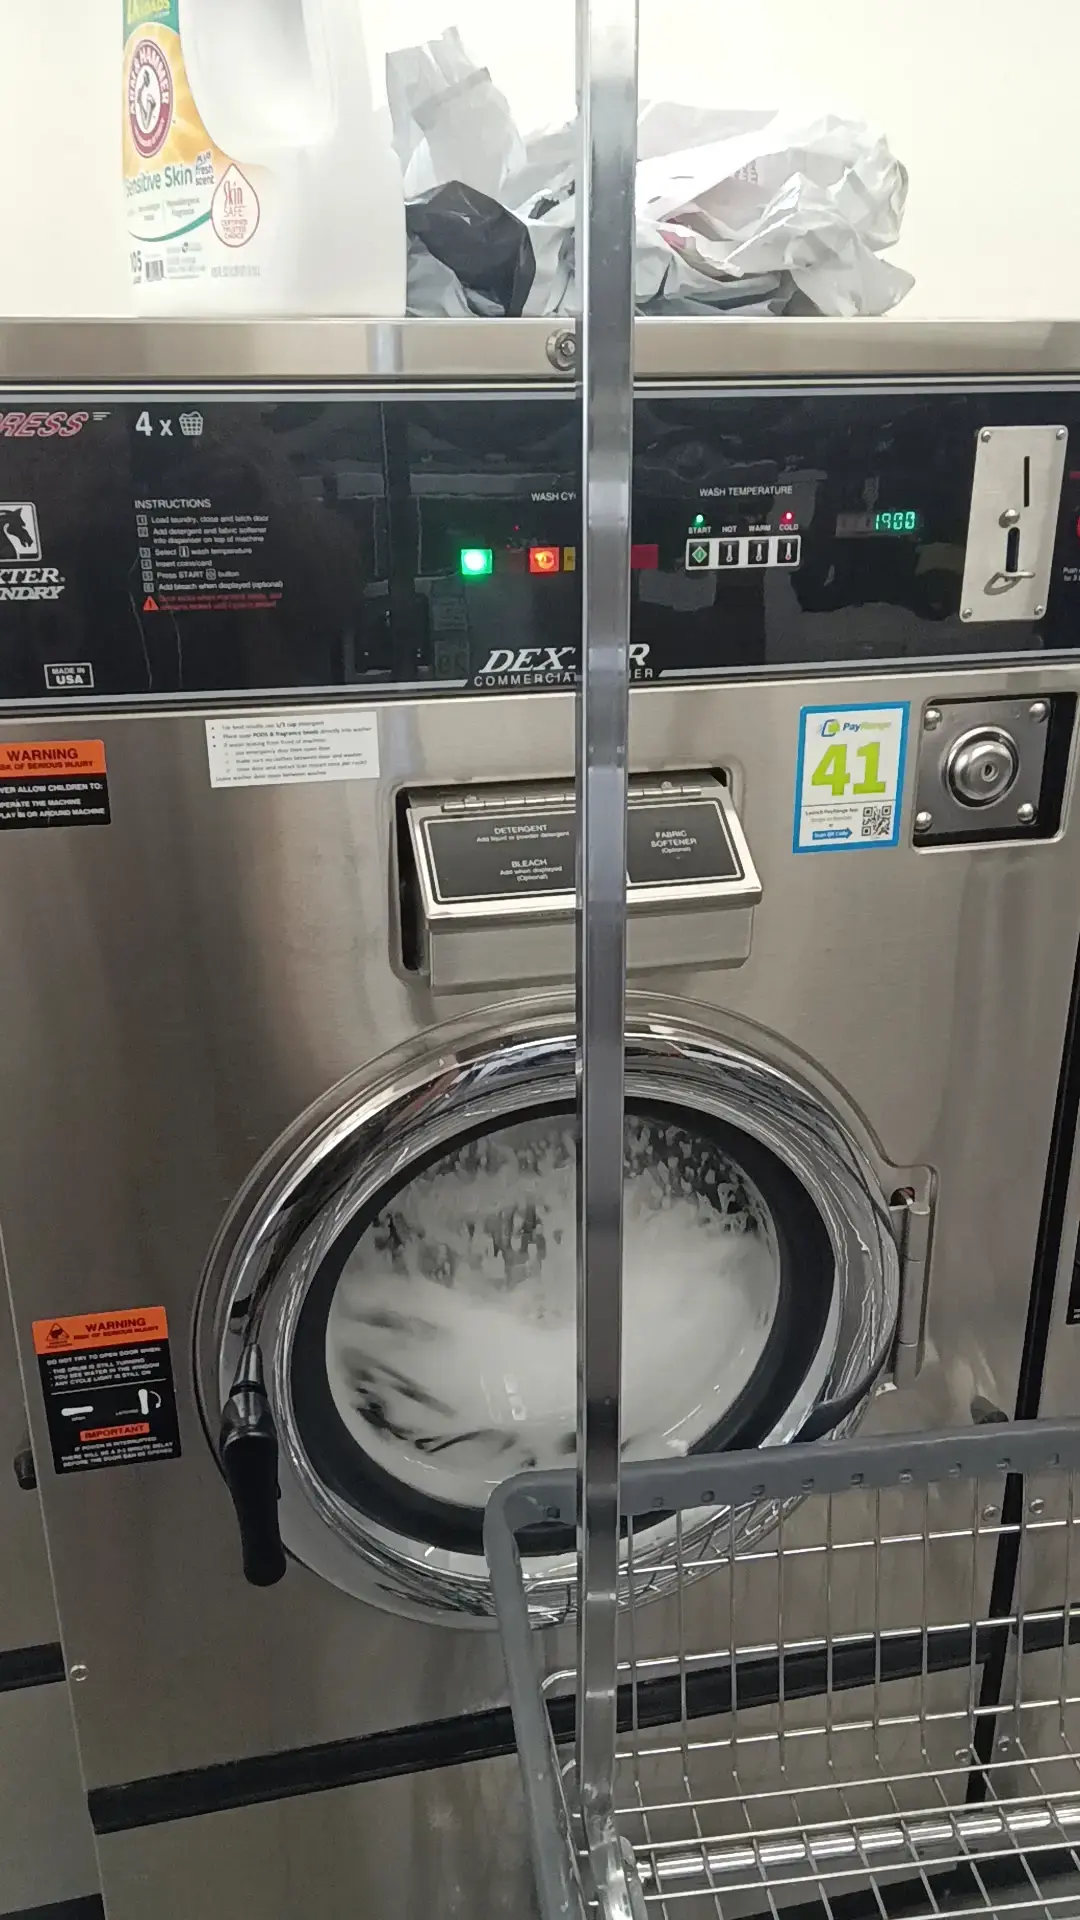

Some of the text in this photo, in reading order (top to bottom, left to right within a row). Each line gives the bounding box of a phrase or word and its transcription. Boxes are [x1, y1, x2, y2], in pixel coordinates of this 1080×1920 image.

[165, 164, 193, 188] Skin
[223, 180, 243, 208] Skin
[0, 411, 89, 437] RESS
[135, 411, 153, 436] 4
[531, 492, 559, 501] WASH
[700, 486, 793, 497] WASH TEMPERATURE
[134, 499, 212, 509] INSTRUCTIONS
[688, 526, 712, 534] START
[722, 525, 737, 533] HOT
[749, 524, 771, 532] WARM
[52, 667, 75, 675] MADE
[56, 674, 84, 685] USA
[6, 748, 78, 761] WARNING
[811, 741, 886, 796] 41
[18, 785, 46, 793] ALLOW
[48, 783, 88, 791] CHILDREN
[0, 800, 30, 808] PERATE
[494, 824, 547, 834] DETERGENT
[655, 829, 687, 838] FABRIC
[651, 837, 697, 847] SOFTENER
[511, 859, 547, 868] BLEACH
[85, 1317, 146, 1332] WARNING
[84, 1424, 144, 1438] IMPORTANT
